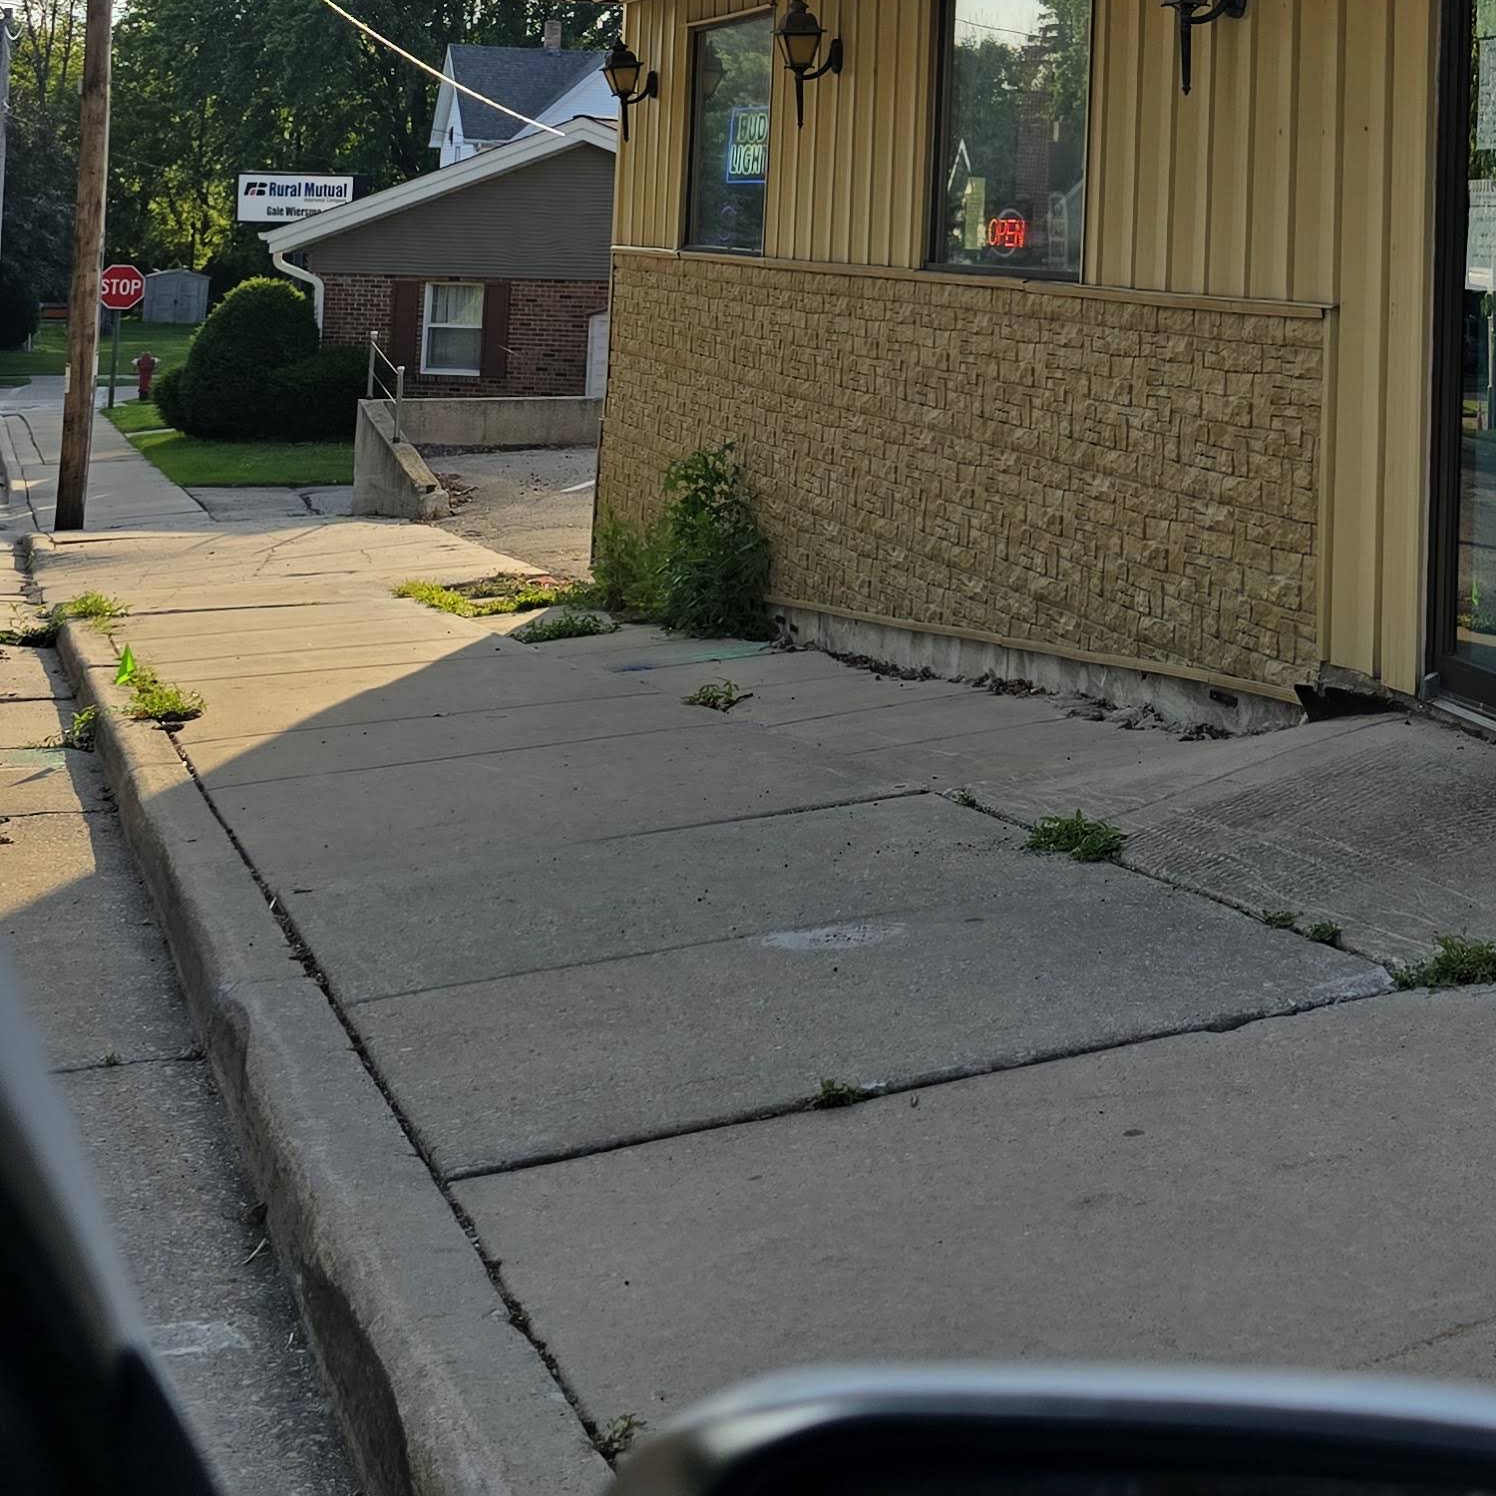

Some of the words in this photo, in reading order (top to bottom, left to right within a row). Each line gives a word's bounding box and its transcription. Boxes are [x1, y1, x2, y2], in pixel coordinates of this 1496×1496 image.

[736, 112, 768, 143] BUD
[269, 182, 302, 197] Rural
[304, 182, 348, 198] Mutual
[266, 205, 284, 216] Gale
[988, 217, 1025, 247] OPEN
[101, 278, 142, 296] STOP
